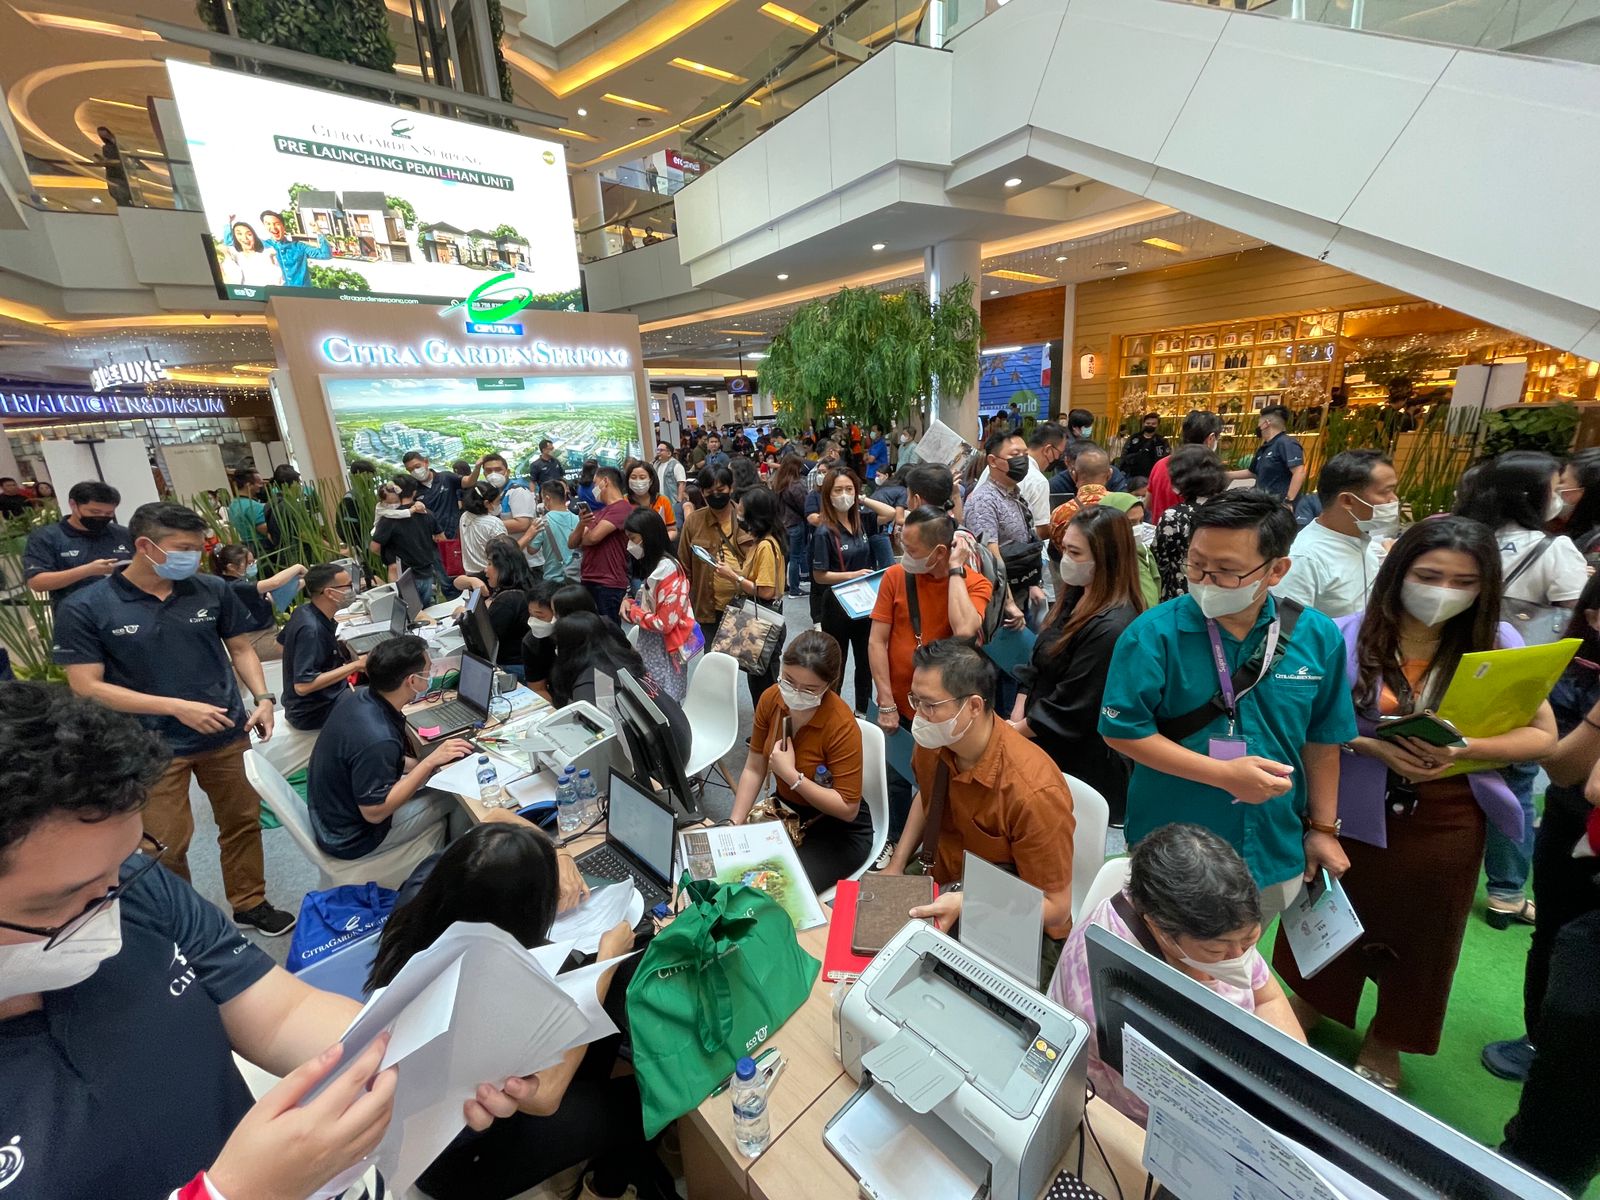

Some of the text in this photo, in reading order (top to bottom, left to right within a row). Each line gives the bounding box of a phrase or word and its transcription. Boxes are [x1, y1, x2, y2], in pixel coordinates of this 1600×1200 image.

[278, 138, 512, 189] PRE LAUNCHING PEMILIHAN UNIT
[473, 324, 515, 334] CIPUTRA
[322, 336, 629, 368] CITRA GARDEN SERPONG
